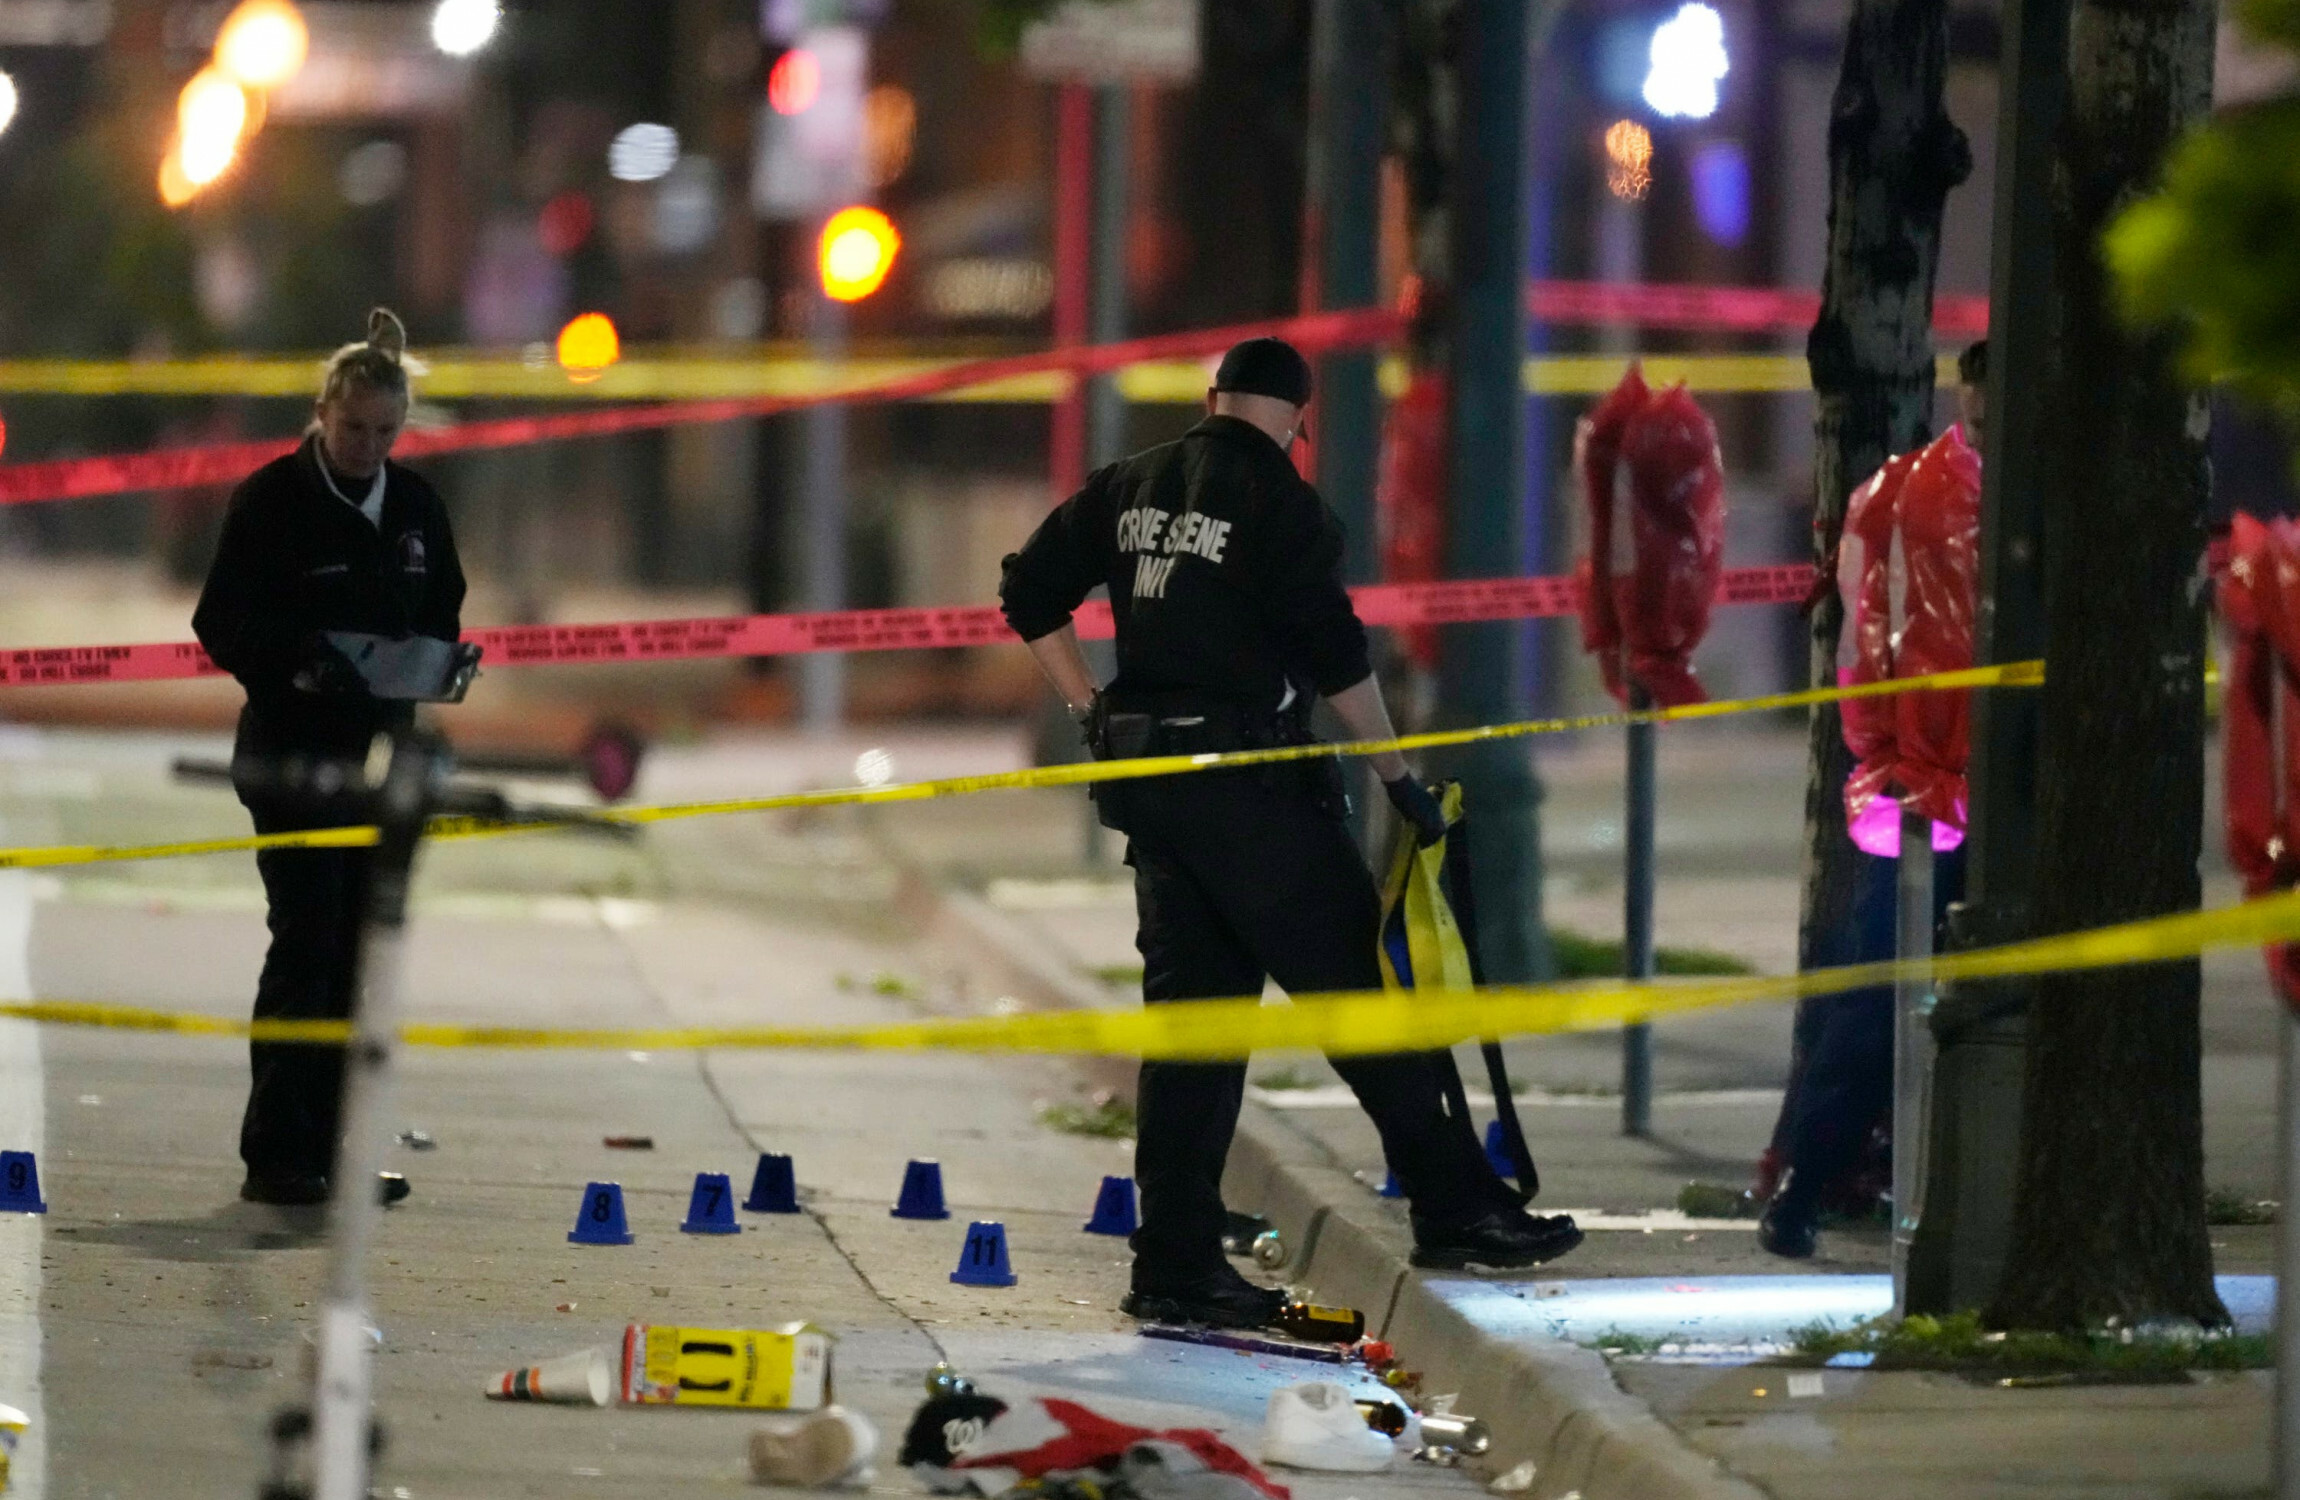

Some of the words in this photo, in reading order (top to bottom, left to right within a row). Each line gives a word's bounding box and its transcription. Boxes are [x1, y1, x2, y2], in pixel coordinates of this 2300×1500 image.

[1117, 507, 1170, 552] CRE
[1163, 511, 1232, 563] SENE
[1133, 554, 1175, 598] NIT
[9, 1162, 27, 1190] 9
[592, 1191, 612, 1223] 8
[703, 1185, 723, 1217] 7
[971, 1235, 997, 1267] 11
